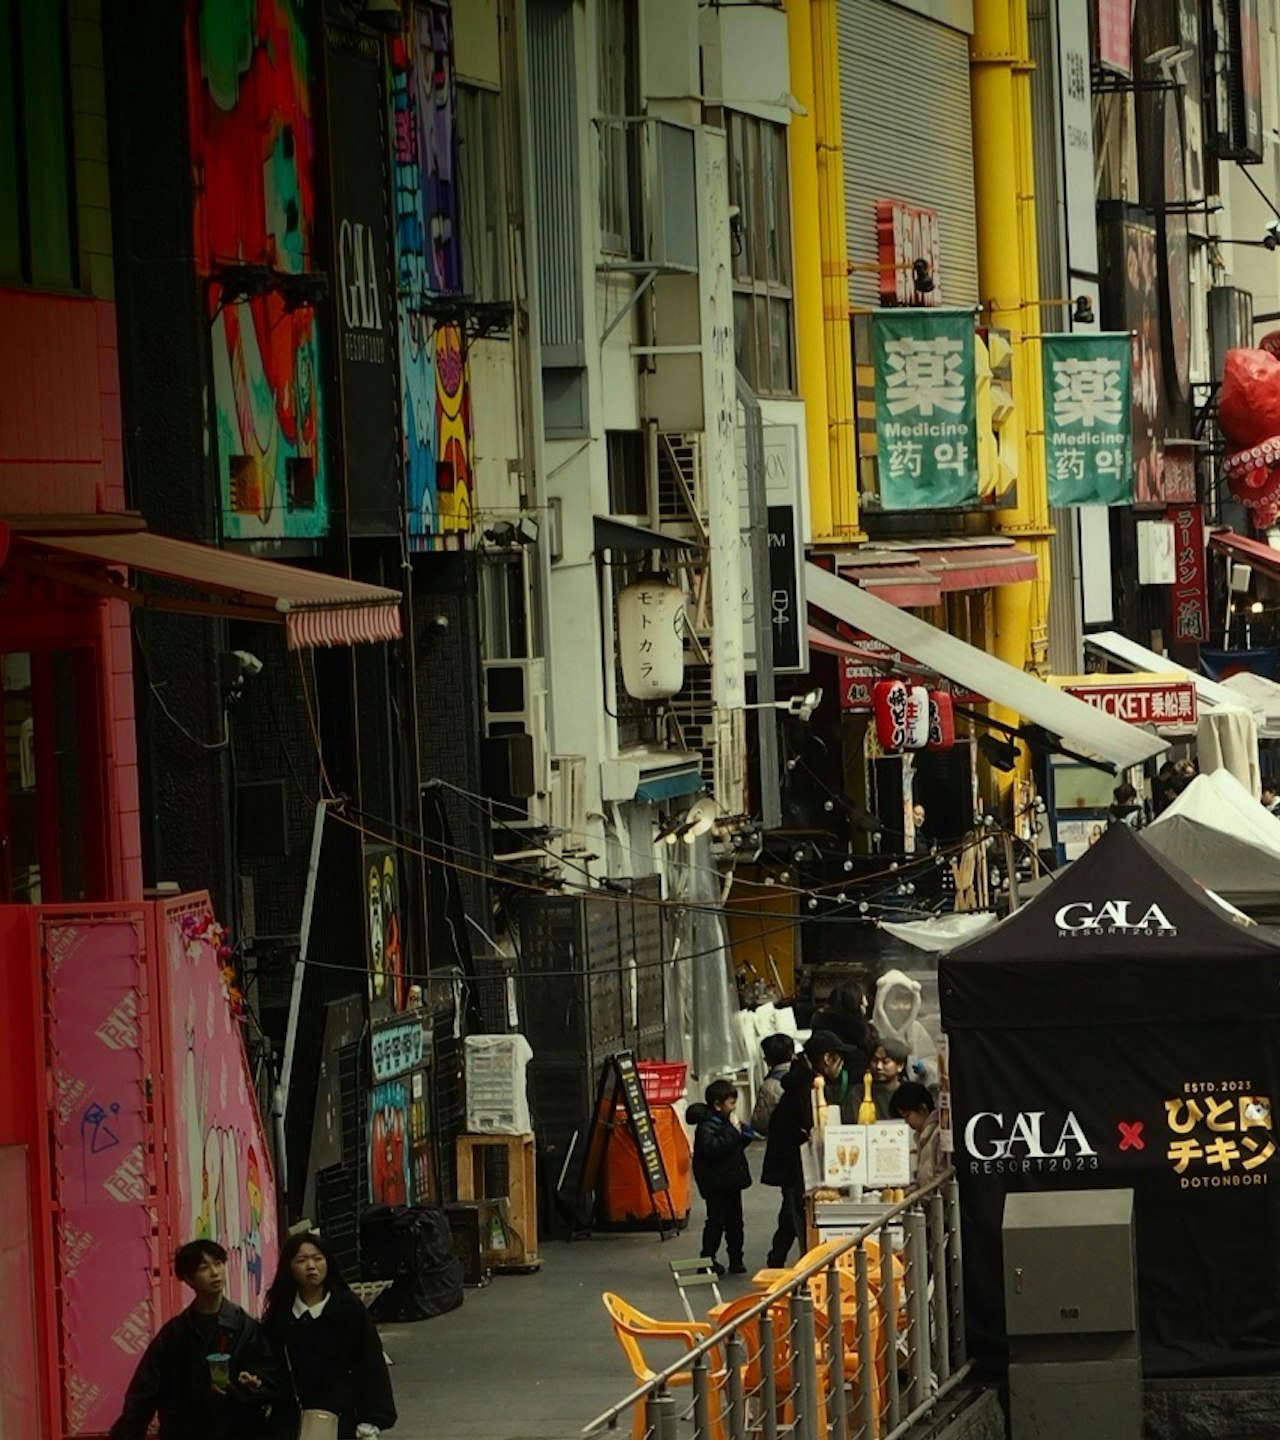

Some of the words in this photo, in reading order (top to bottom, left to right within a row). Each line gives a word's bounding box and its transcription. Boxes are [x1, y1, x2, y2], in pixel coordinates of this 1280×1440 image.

[339, 218, 384, 330] GALA
[884, 336, 966, 417] 薬
[1052, 357, 1122, 428] 薬
[884, 422, 969, 437] Medicine
[1052, 432, 1125, 446] Medicine
[887, 441, 923, 479] 药
[934, 441, 968, 477] 약
[1054, 449, 1086, 481] 药
[1095, 449, 1125, 481] 약
[636, 591, 654, 679] モトカラ
[1083, 692, 1150, 719] TICKET
[1055, 900, 1177, 930] GALA
[1058, 926, 1178, 938] RESORT2023
[1164, 1095, 1273, 1134] ひと口
[963, 1110, 1098, 1161] GALA
[969, 1156, 1100, 1175] RESORT2023
[1167, 1137, 1276, 1174] チキン
[1180, 1174, 1268, 1189] DOTONBORI
